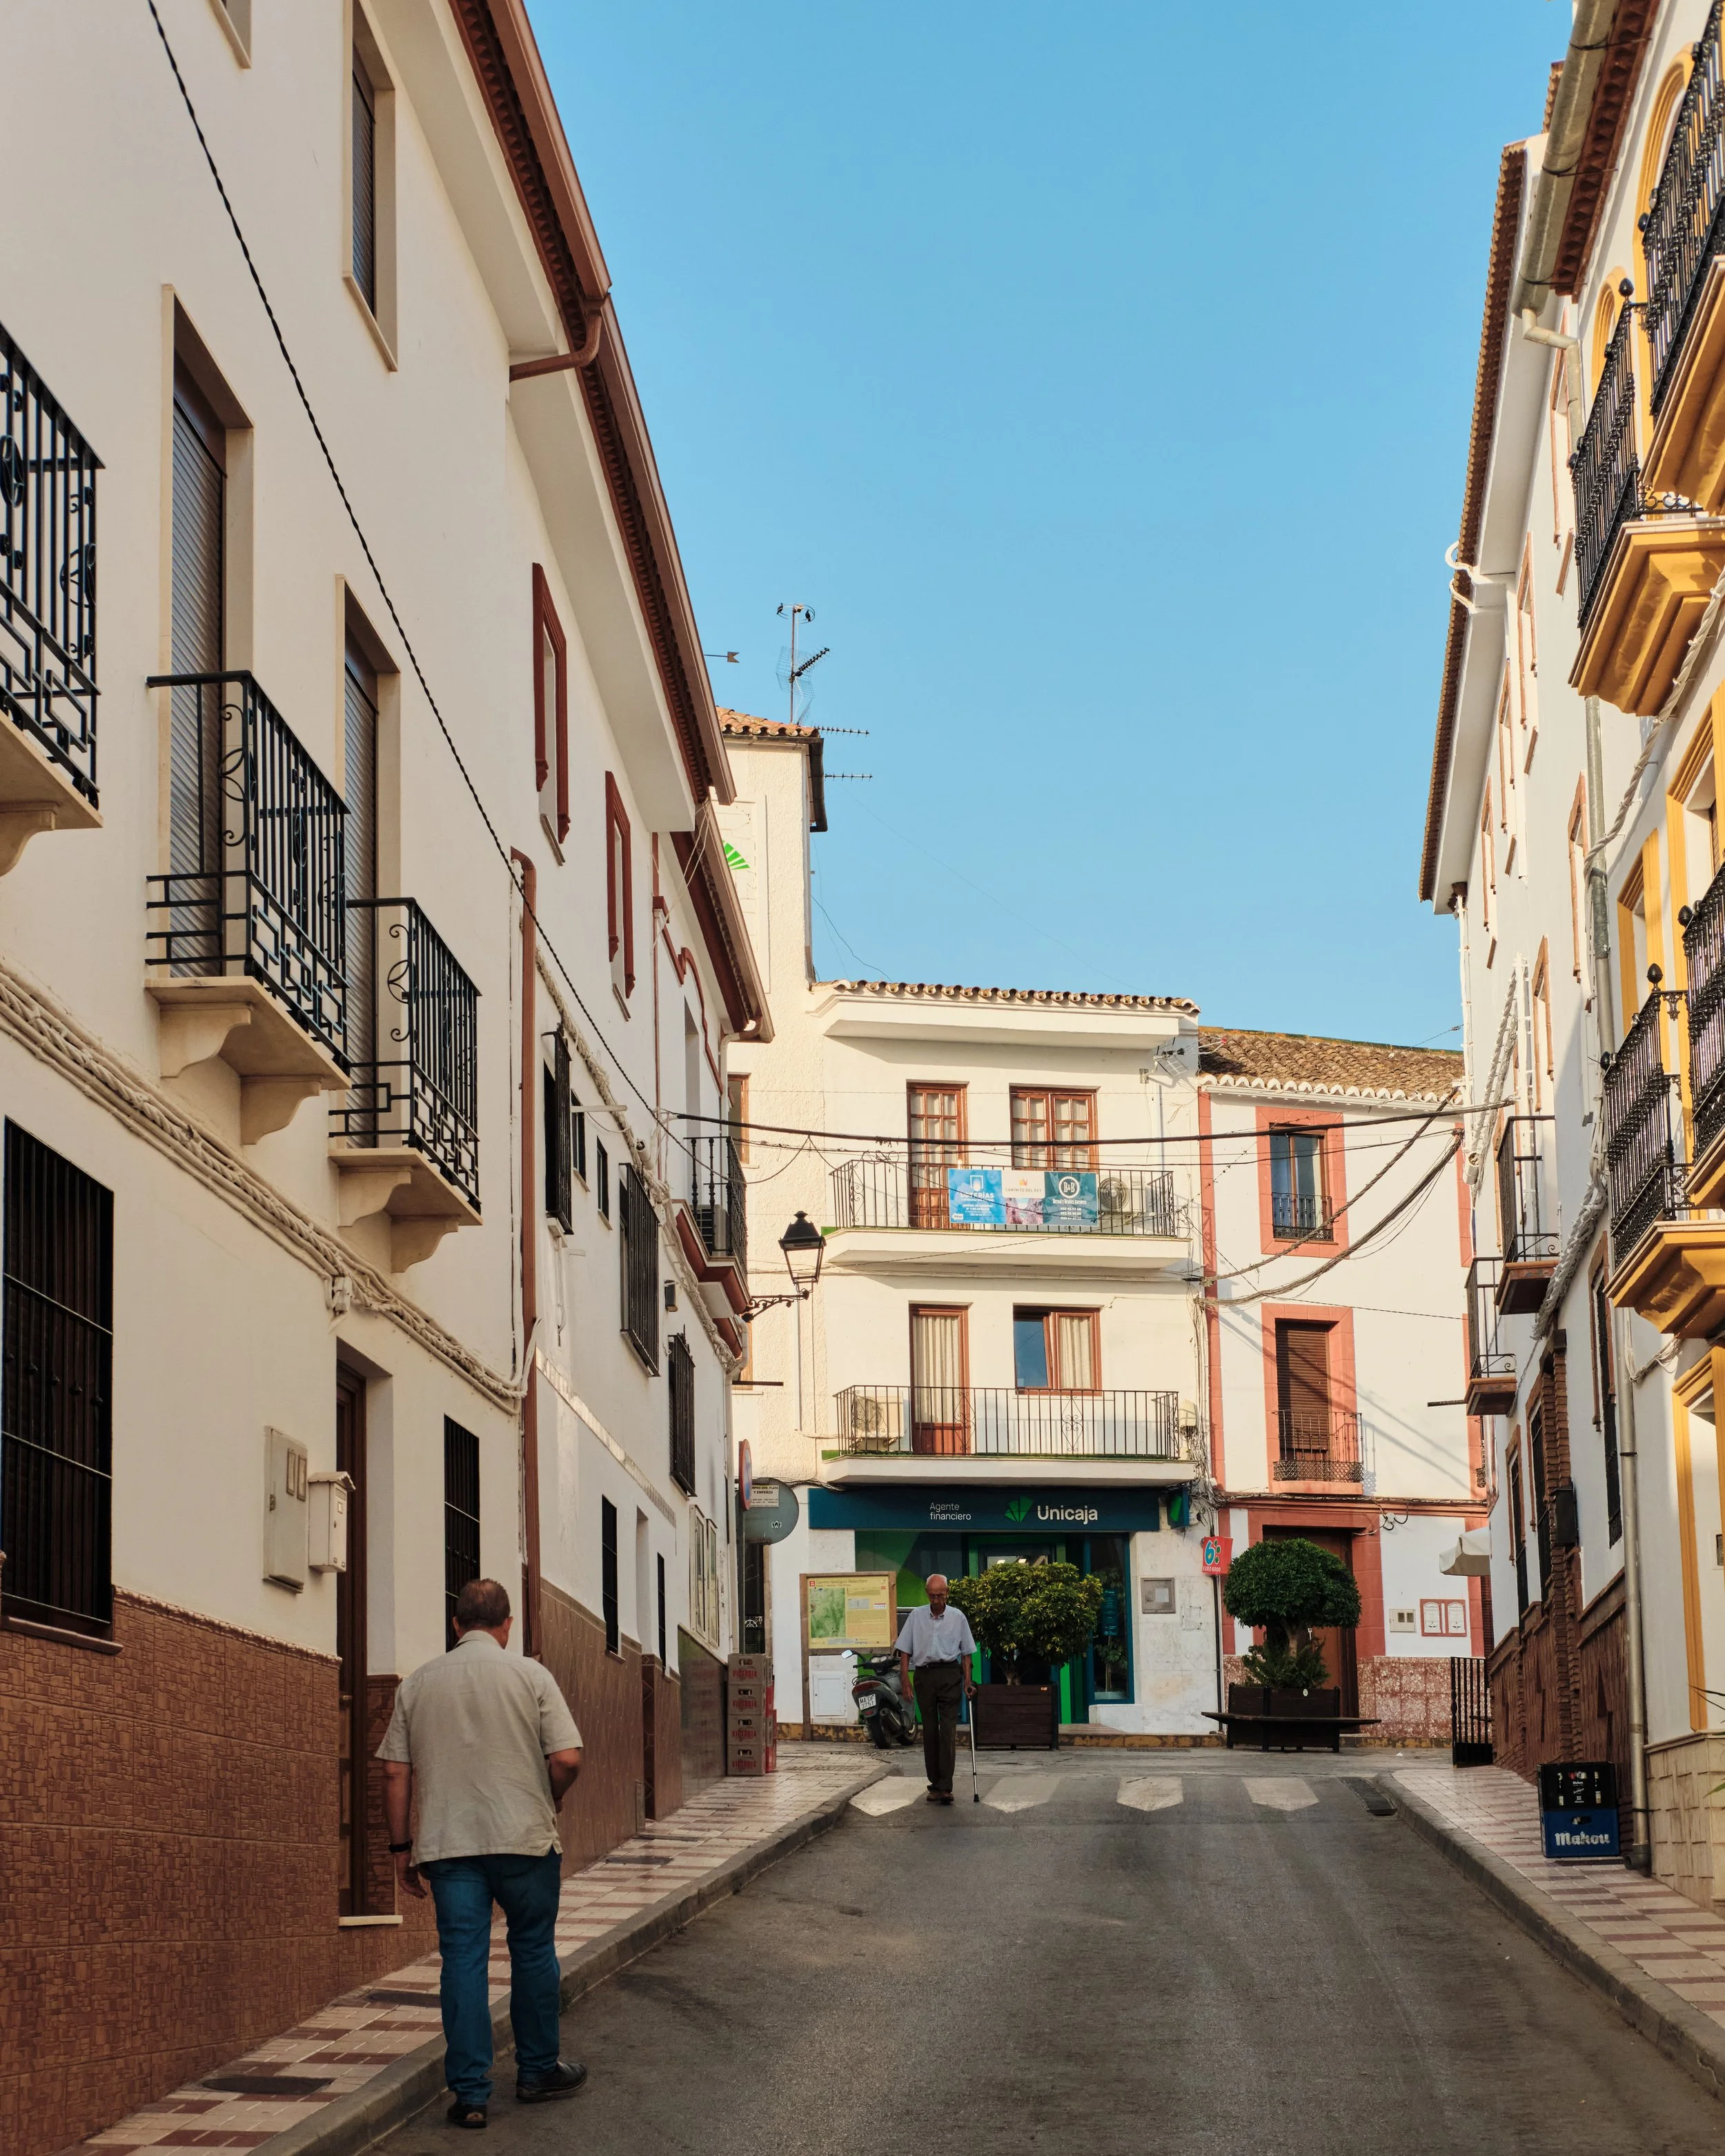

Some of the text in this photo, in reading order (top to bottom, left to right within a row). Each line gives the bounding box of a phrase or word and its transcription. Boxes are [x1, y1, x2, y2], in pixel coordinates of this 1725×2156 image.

[1063, 1182, 1075, 1193] B&B
[929, 1502, 960, 1513] Agente
[929, 1512, 972, 1521] financiero
[1037, 1505, 1098, 1525] Unicaja
[732, 1669, 757, 1679] VICTORIA
[732, 1699, 757, 1708] VICTORIA
[861, 1701, 874, 1709] 3751
[732, 1730, 756, 1738] VICTORIA
[731, 1760, 756, 1769] VICTORIA
